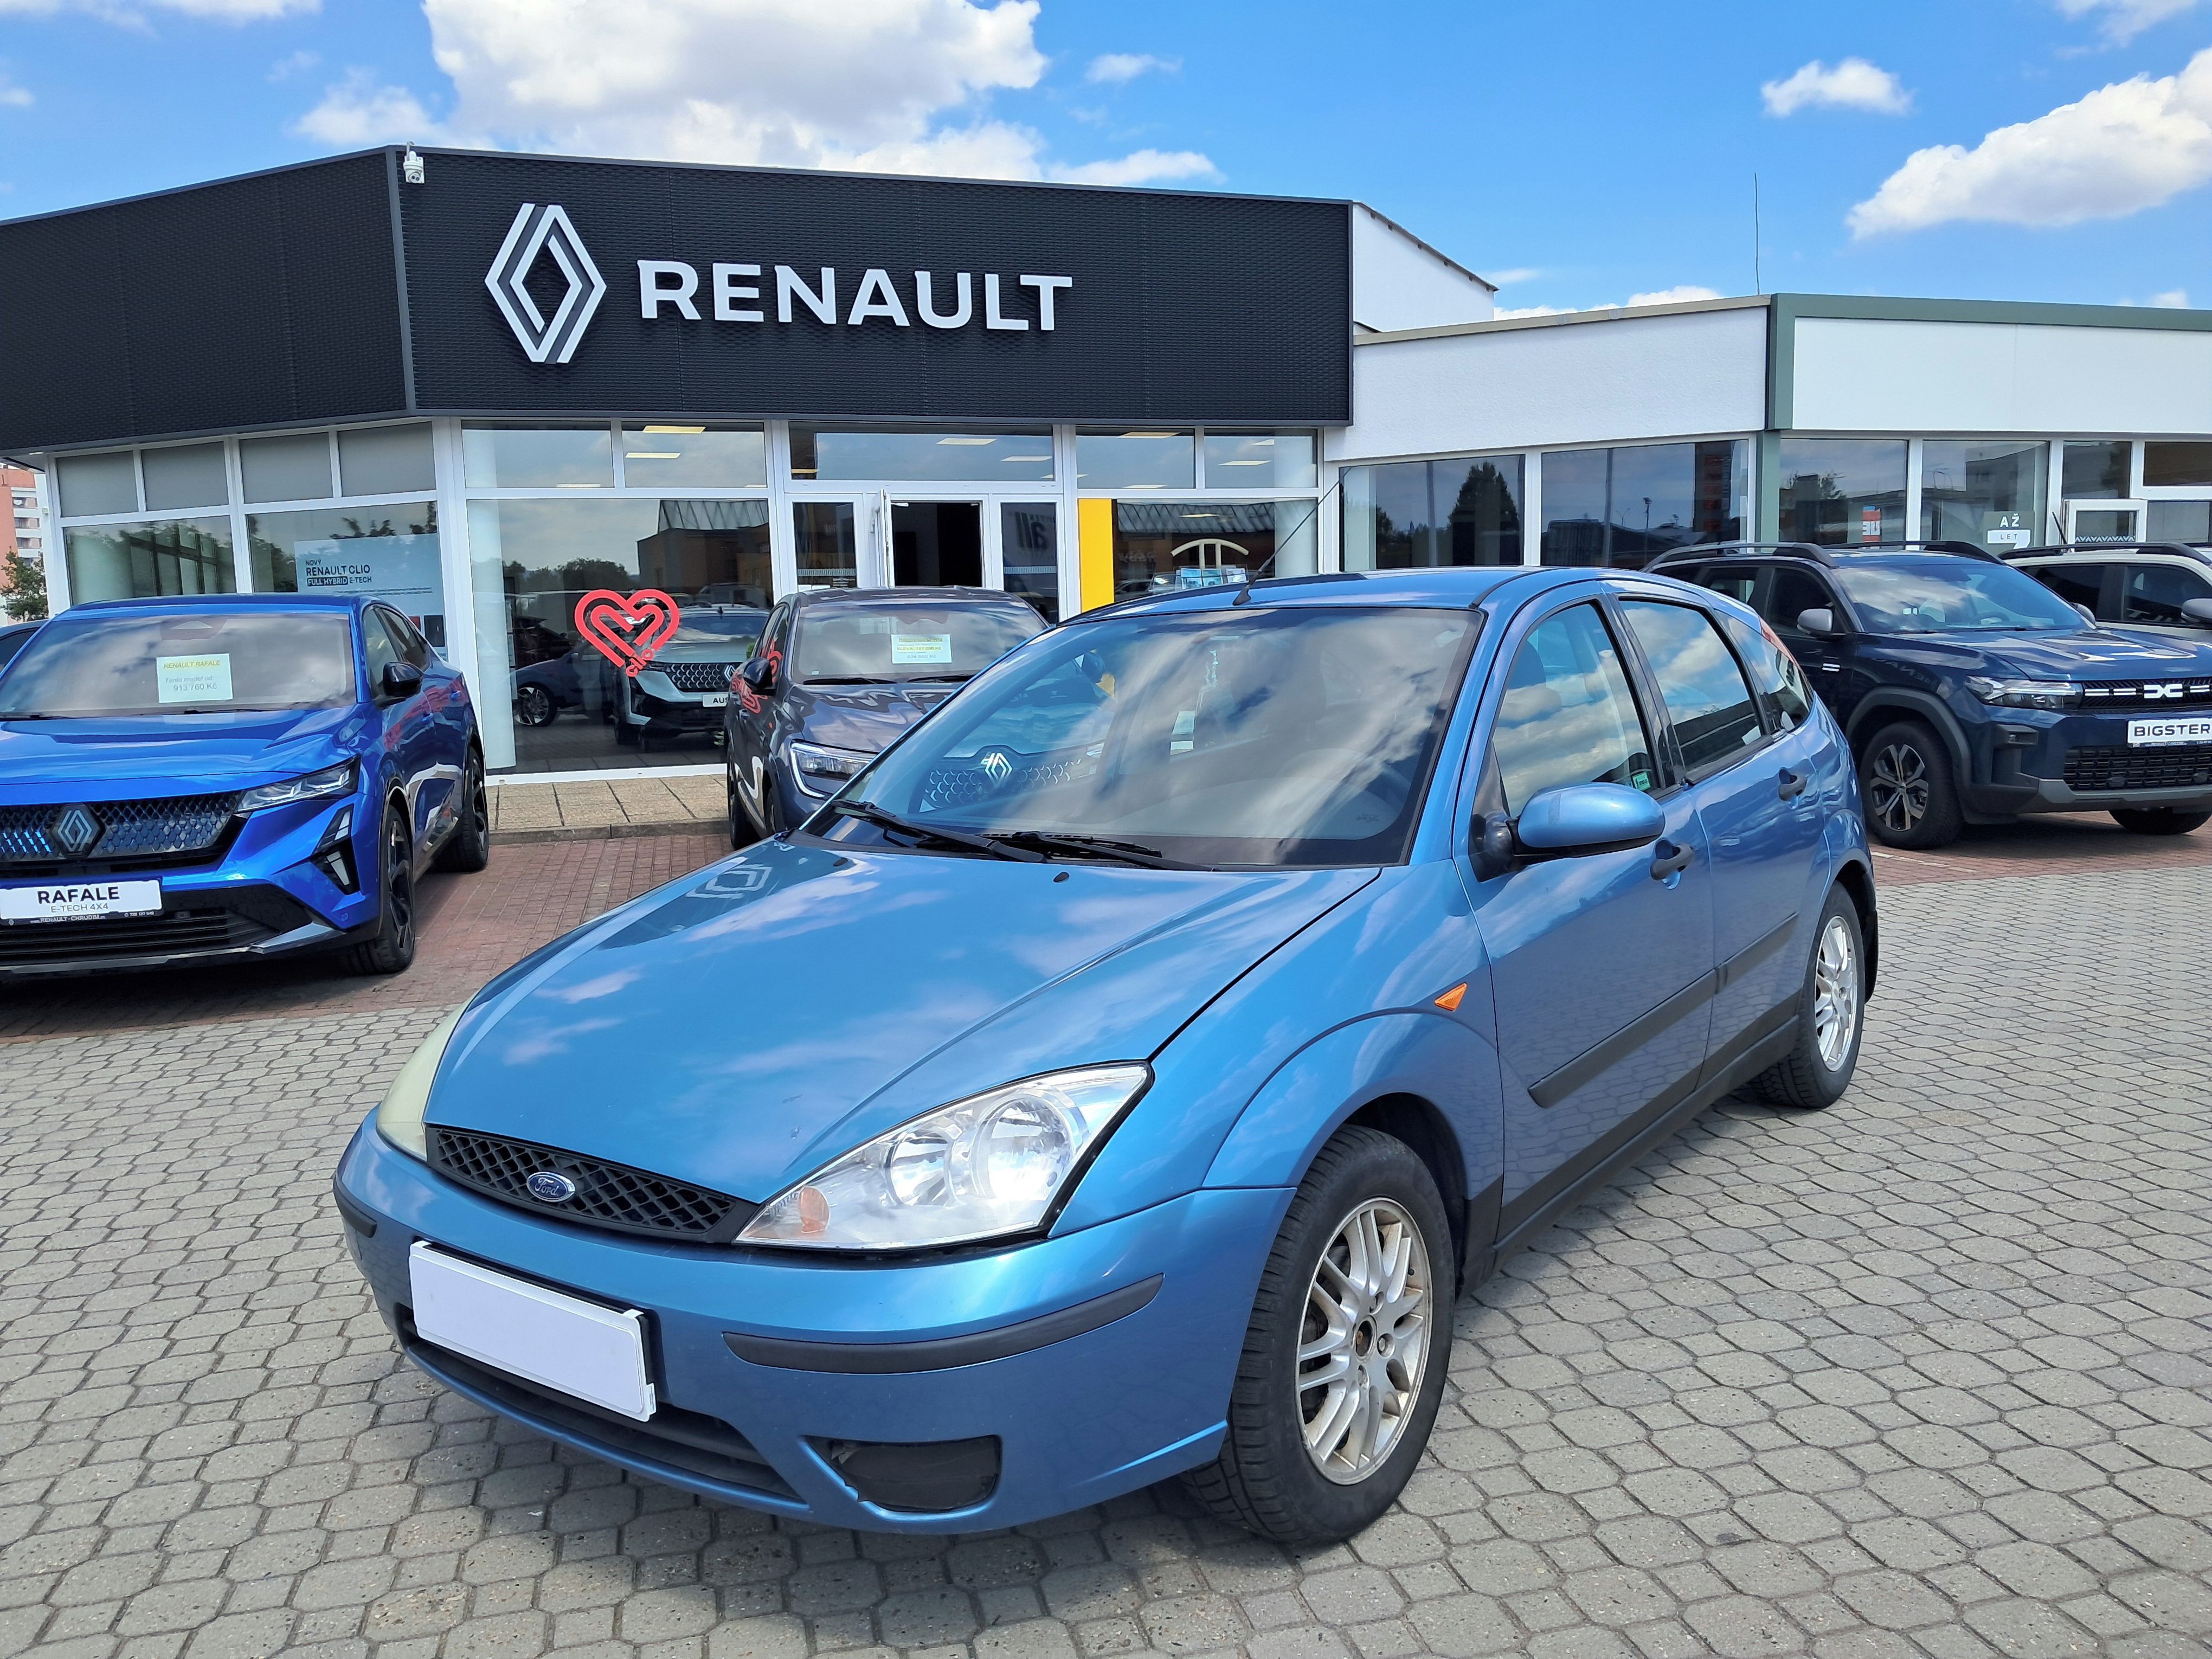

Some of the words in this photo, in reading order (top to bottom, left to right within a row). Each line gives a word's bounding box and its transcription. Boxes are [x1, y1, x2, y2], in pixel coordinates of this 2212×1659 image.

[636, 260, 1072, 331] RENAULT
[1999, 513, 2020, 528] AŽ
[305, 558, 321, 566] NOVÝ
[306, 565, 347, 576] RENAULT
[349, 564, 370, 575] CLIO
[324, 577, 348, 585] HYBRID
[2134, 723, 2210, 737] BIGSTER
[37, 886, 120, 904] RAFALE
[51, 904, 88, 913] E-TECH
[535, 1177, 560, 1196] Ford
